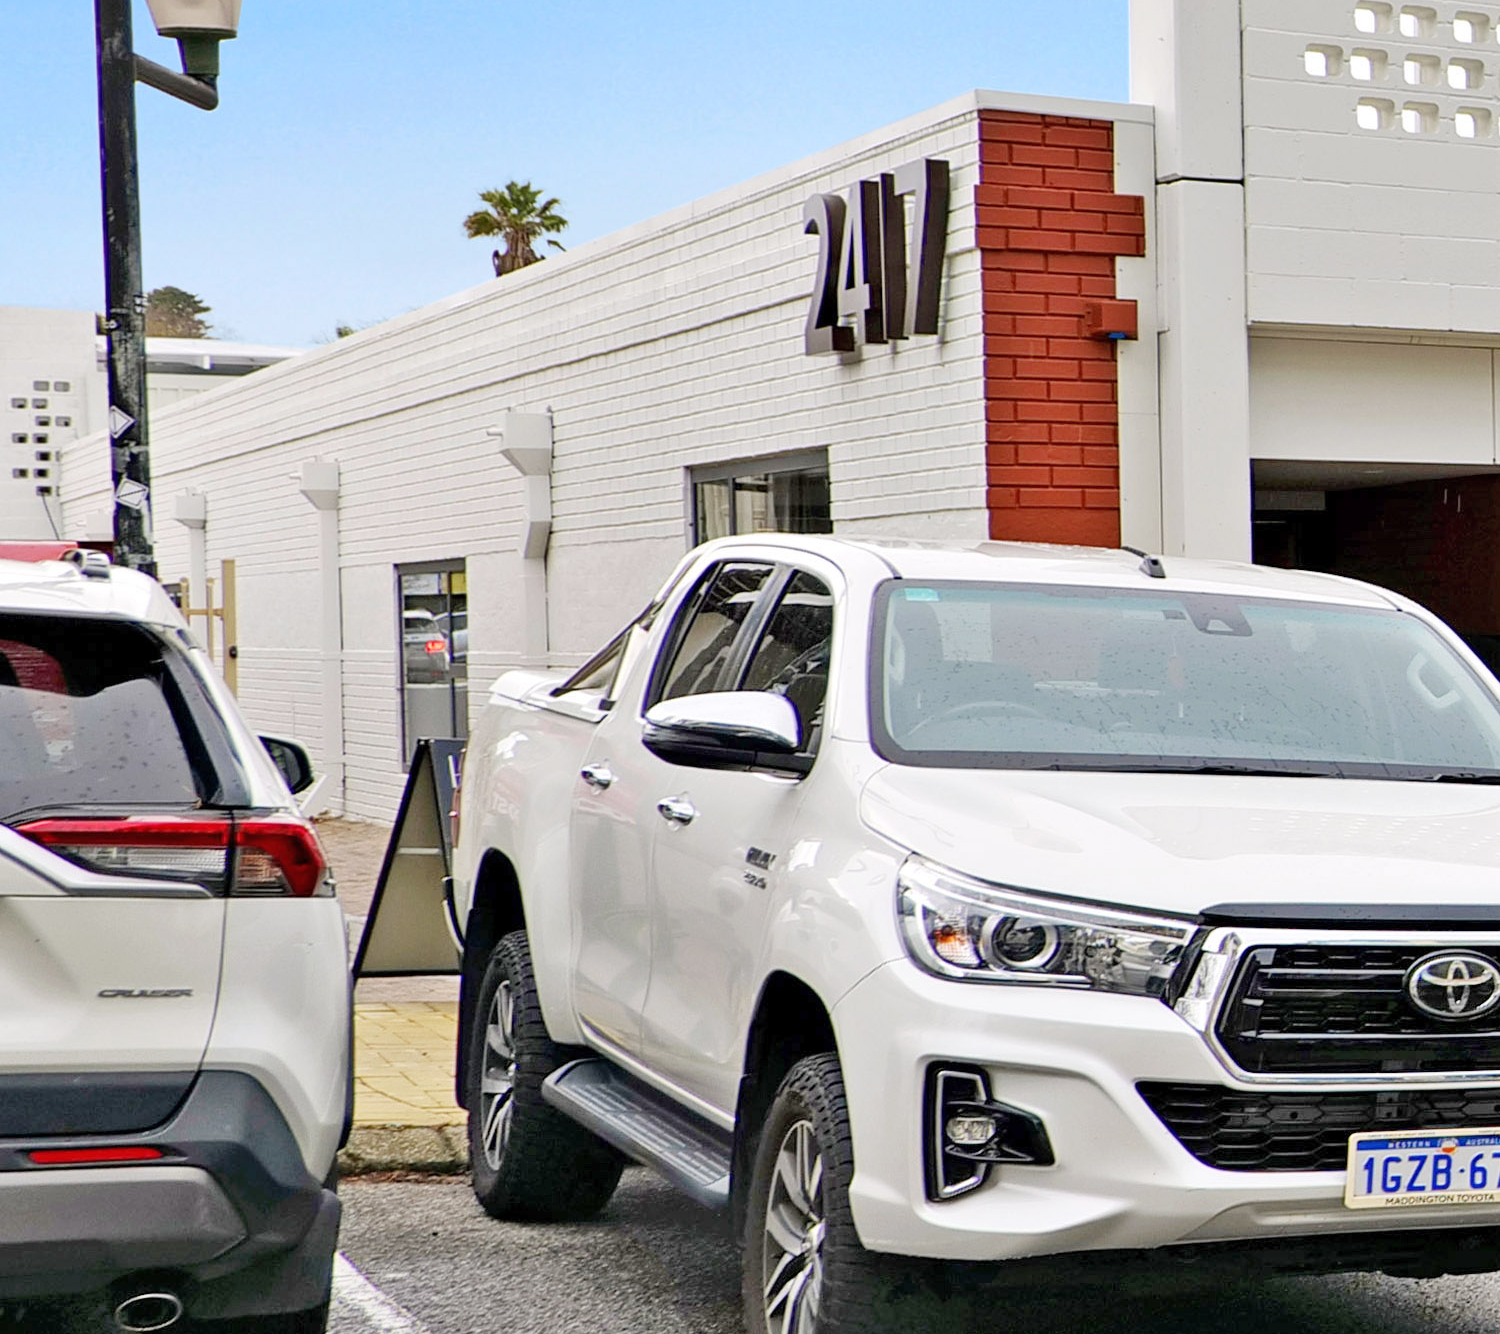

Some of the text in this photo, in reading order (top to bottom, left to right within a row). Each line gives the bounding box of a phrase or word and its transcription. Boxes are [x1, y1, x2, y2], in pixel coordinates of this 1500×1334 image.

[1387, 1140, 1431, 1150] WESTERN
[1384, 1193, 1496, 1206] MADDINGTON TOYOTA
